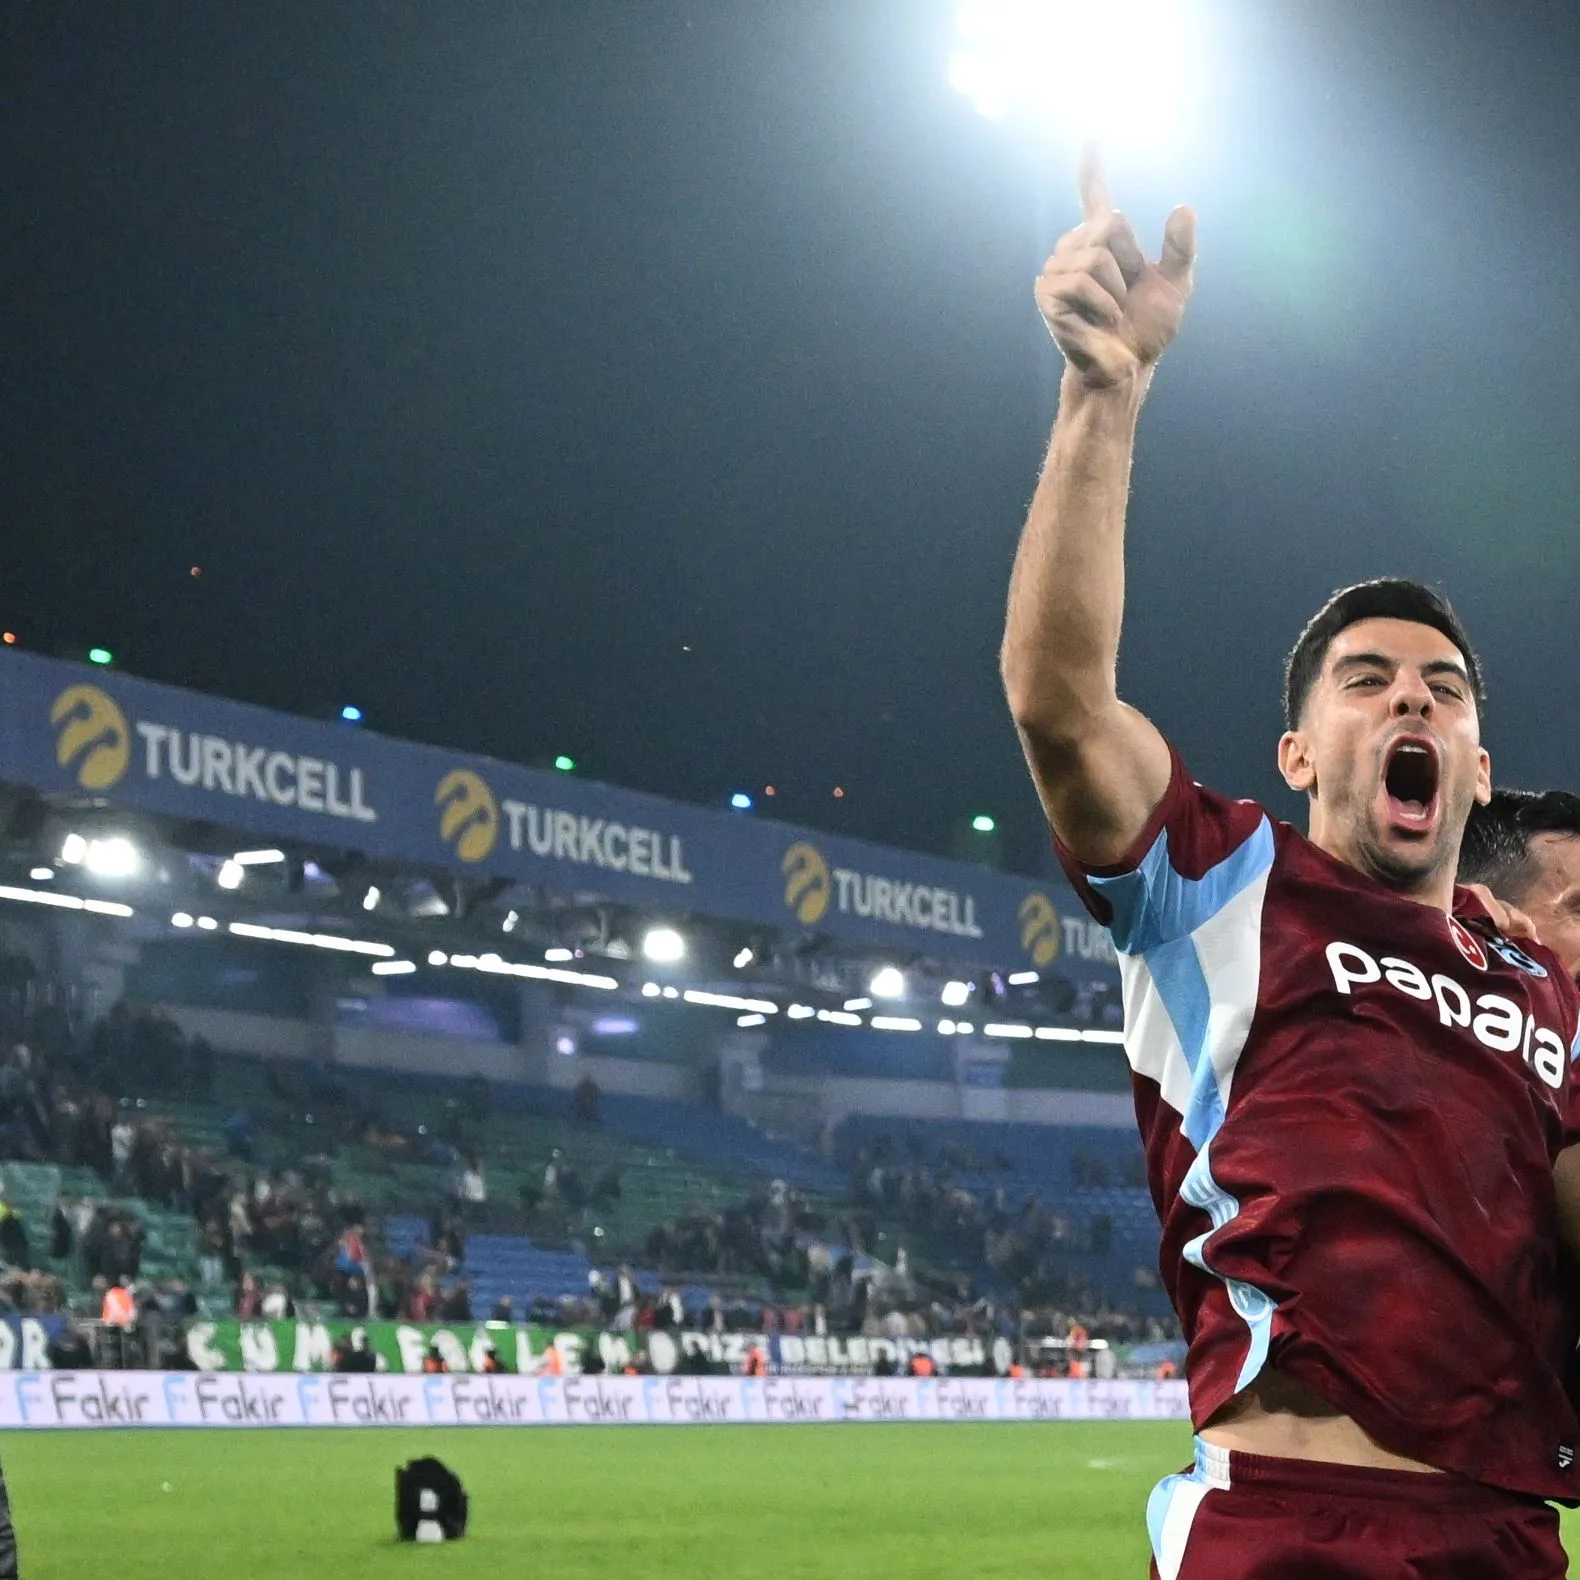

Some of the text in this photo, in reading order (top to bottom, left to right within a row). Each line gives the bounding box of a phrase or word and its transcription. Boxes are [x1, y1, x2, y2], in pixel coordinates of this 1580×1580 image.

[136, 720, 378, 823] TURKCELL
[502, 799, 693, 884] TURKCELL
[832, 867, 985, 940] TURKCELL
[1325, 942, 1566, 1090] papara
[51, 1373, 150, 1422] Fakir
[195, 1374, 284, 1421] Fakir
[328, 1376, 413, 1421] Fakir
[451, 1376, 526, 1420] Fakir
